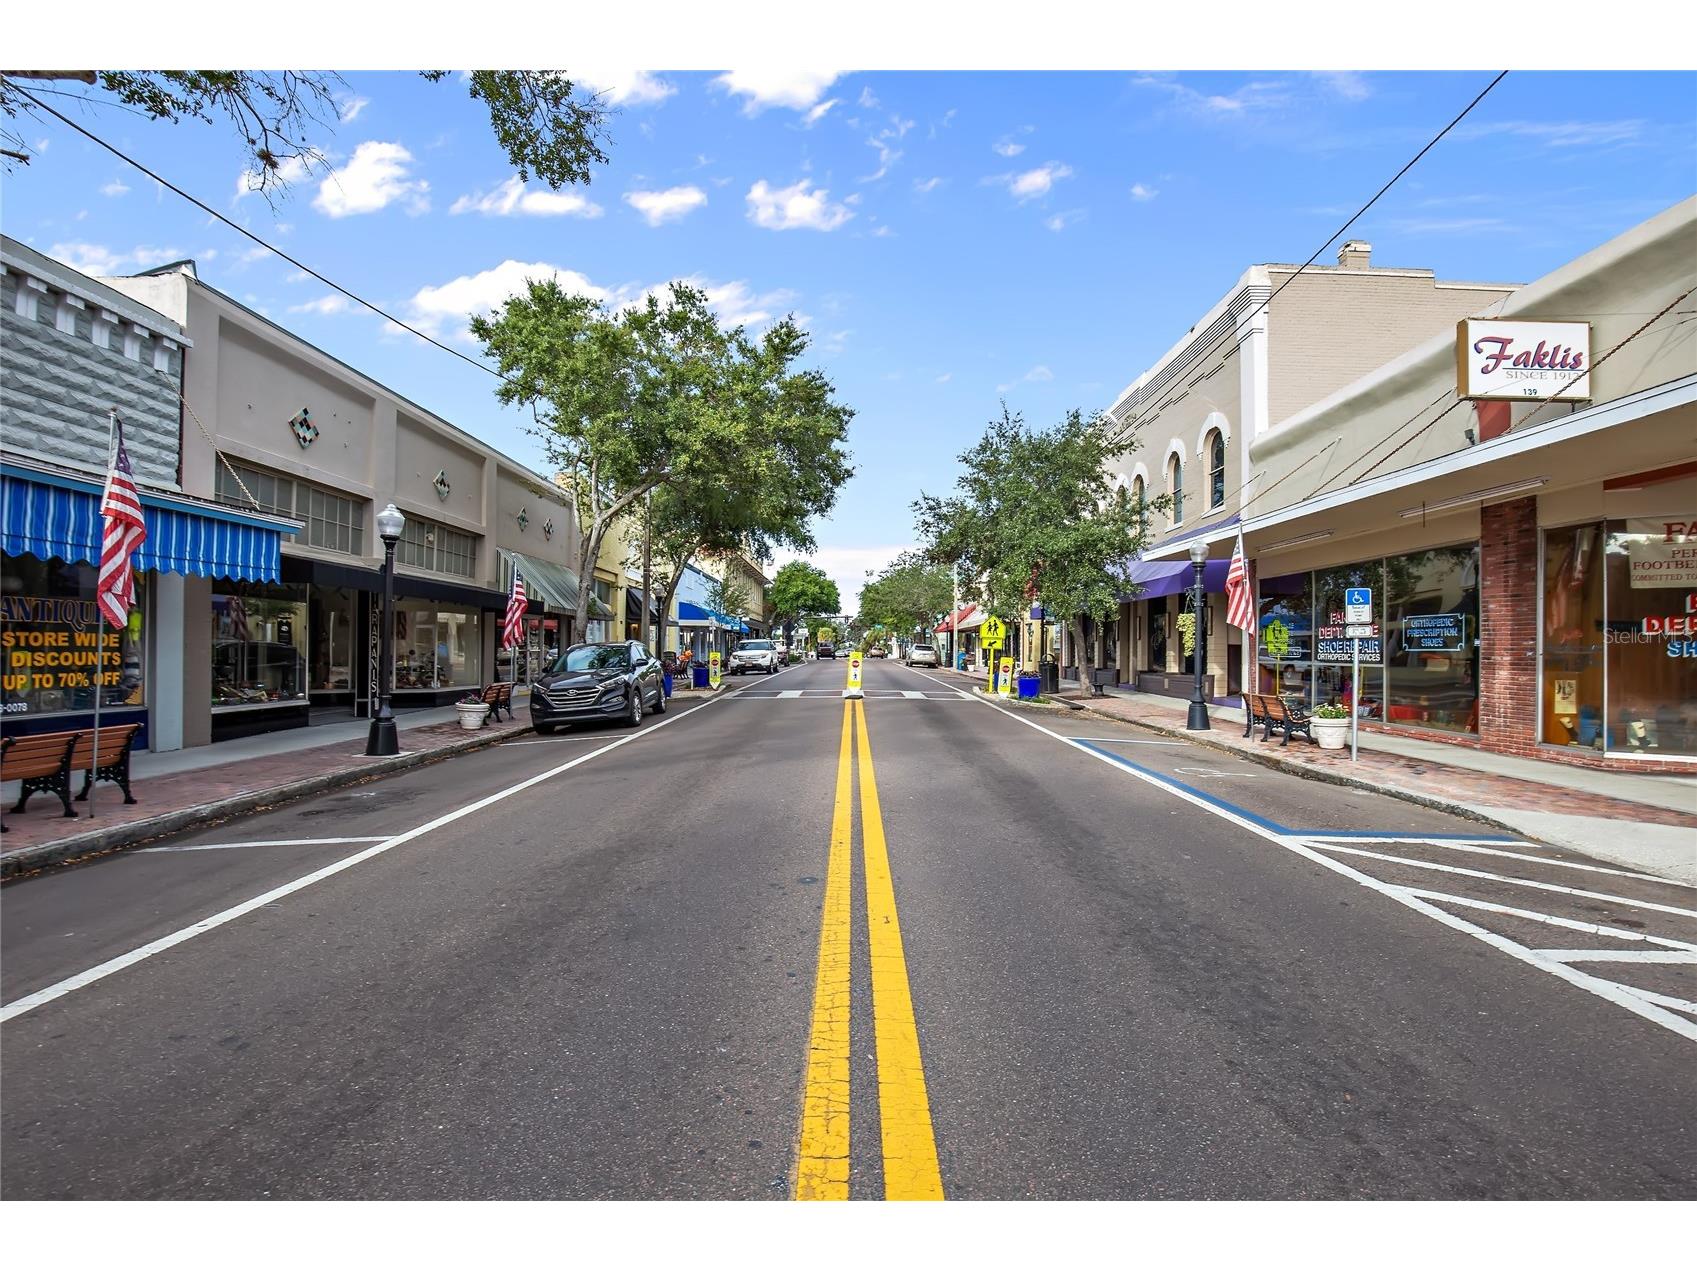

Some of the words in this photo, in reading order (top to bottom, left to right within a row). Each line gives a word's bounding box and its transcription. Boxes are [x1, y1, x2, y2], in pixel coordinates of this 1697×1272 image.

[1474, 336, 1583, 375] Faklis
[1506, 370, 1548, 380] SINCE
[1523, 388, 1538, 396] 139
[1407, 628, 1458, 637] PRESCRIPTION
[2, 632, 69, 647] STORE
[75, 633, 119, 647] WIDE
[1421, 638, 1443, 646] SHOES
[1318, 641, 1344, 653] SHOE
[12, 652, 121, 667] DISCOUNTS
[1317, 653, 1350, 661] ORTHOPEDIC
[1351, 653, 1380, 661] SRVICES
[3, 675, 27, 690] UP
[32, 673, 53, 688] TO
[58, 673, 89, 687] 70%
[94, 672, 120, 686] OFF
